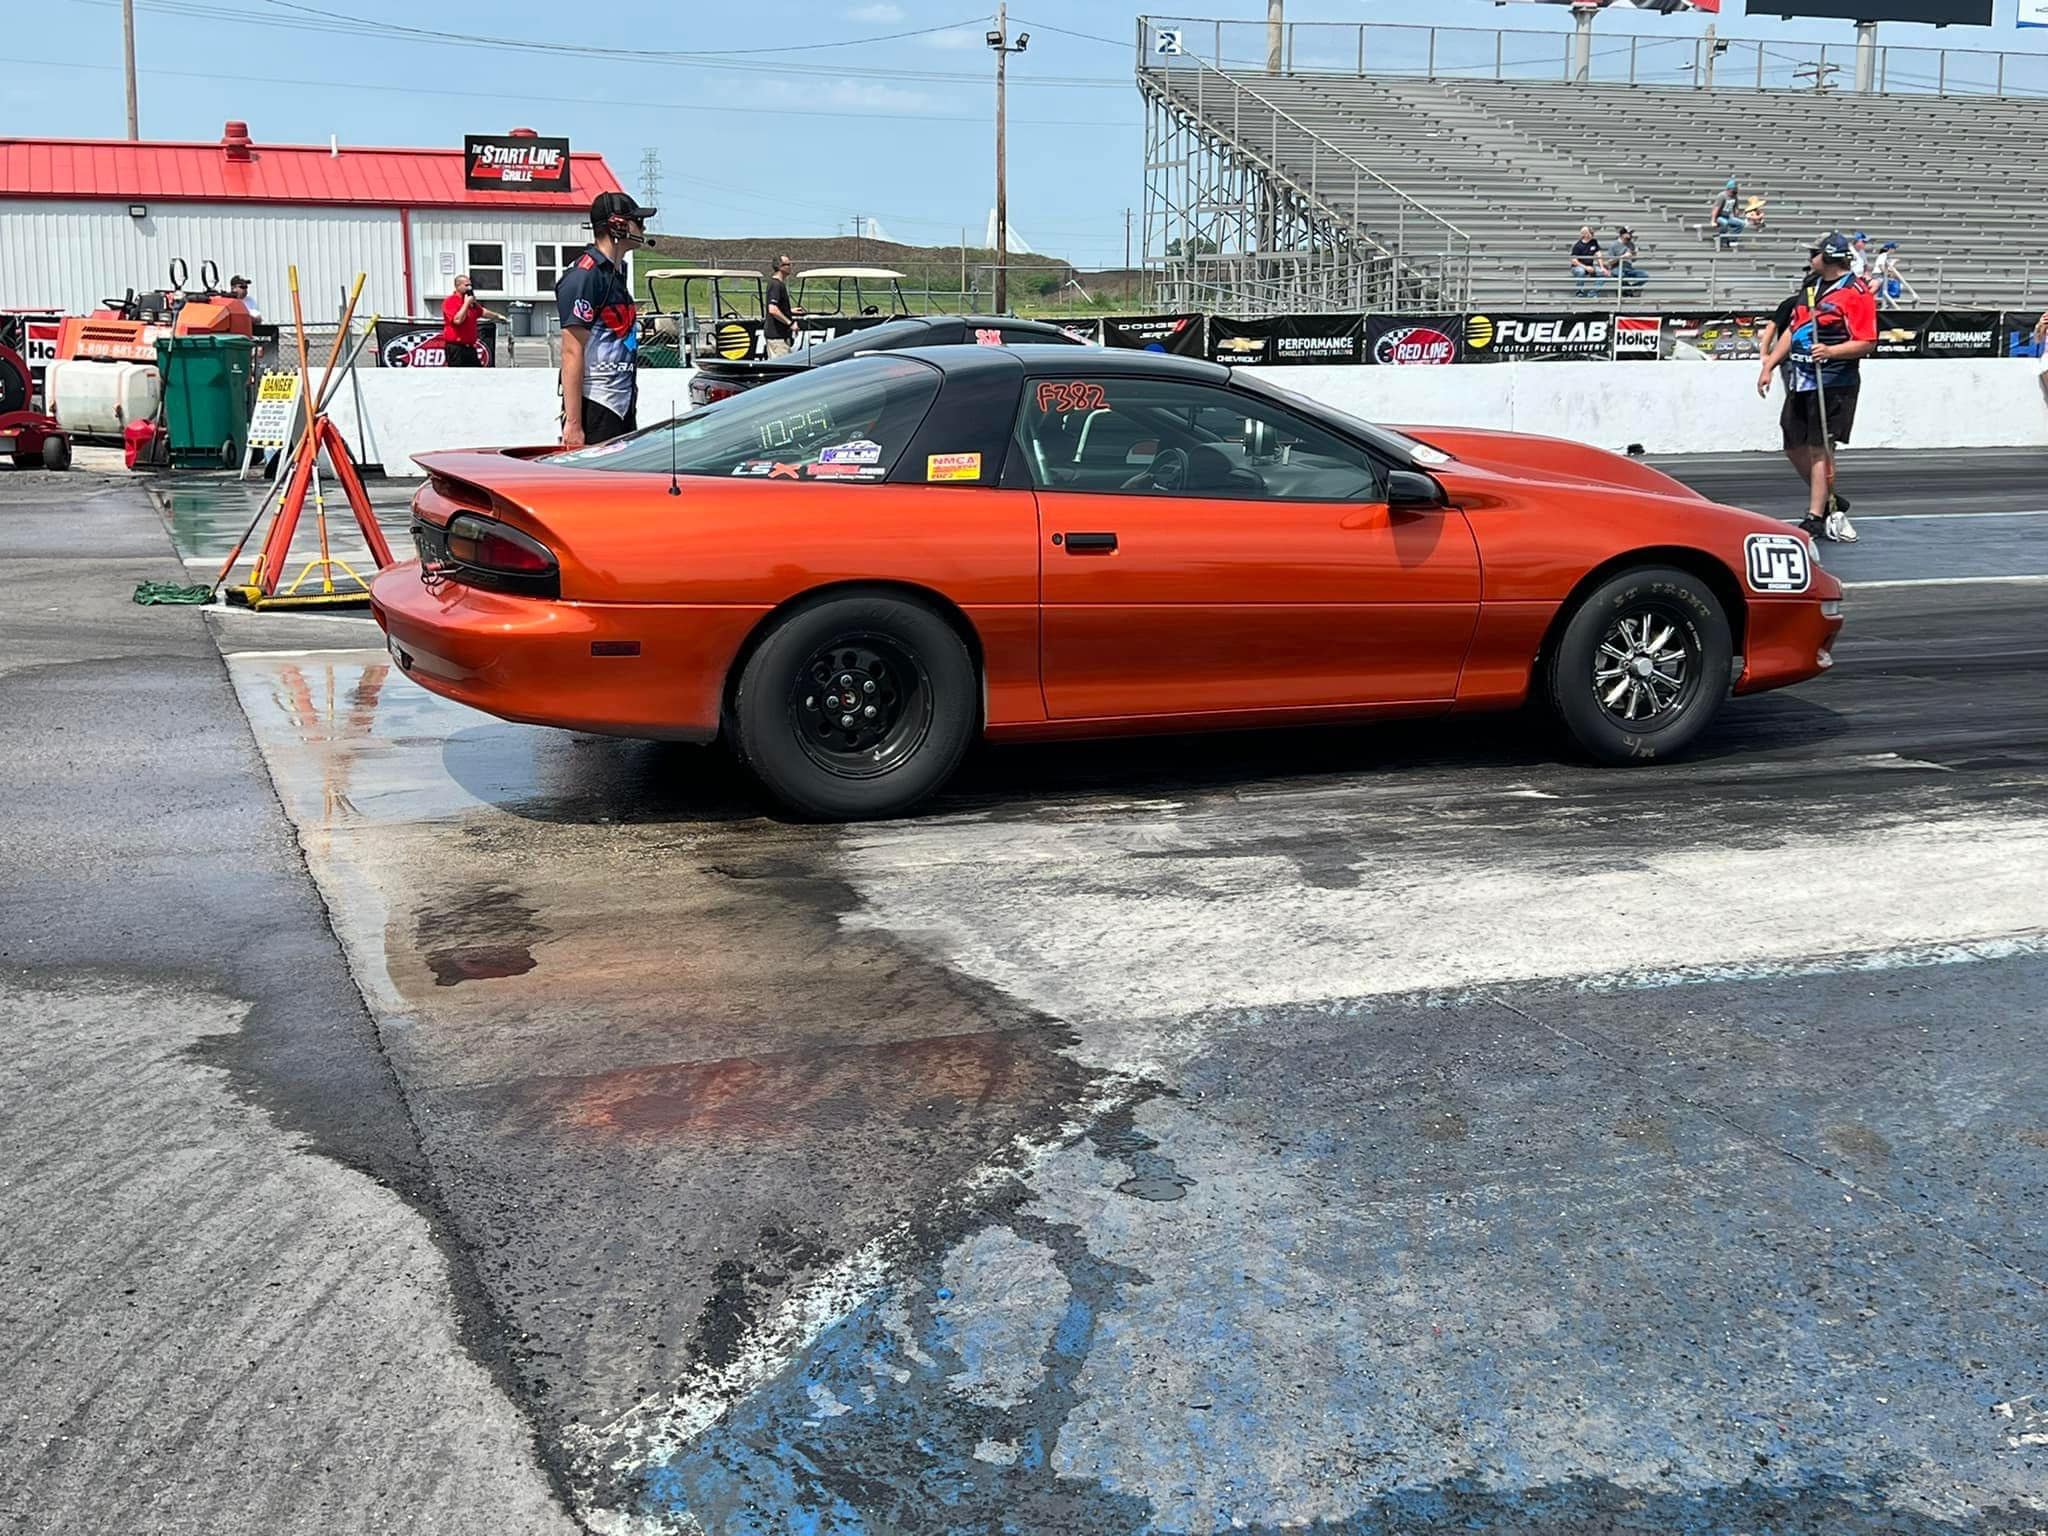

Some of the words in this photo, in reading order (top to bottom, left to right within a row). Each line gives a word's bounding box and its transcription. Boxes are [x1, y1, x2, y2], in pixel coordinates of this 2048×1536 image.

[1158, 32, 1177, 53] 2
[482, 145, 528, 165] START
[528, 146, 561, 166] LINE
[501, 169, 534, 182] GRILLE
[1118, 322, 1177, 331] DODGE
[1496, 320, 1609, 344] FUELAB
[1278, 336, 1354, 350] PERFORMANCE
[1616, 331, 1658, 350] Holley
[1928, 331, 1993, 342] PERFORMANCE
[1396, 343, 1422, 360] RED
[1422, 341, 1450, 360] LINE
[1492, 345, 1530, 353] DIGITAL
[1535, 344, 1557, 352] FUEL
[1561, 343, 1607, 352] DELIVERY
[414, 348, 446, 366] RED
[263, 378, 294, 392] DANGER
[1037, 381, 1110, 412] F382
[933, 456, 976, 465] NMCA
